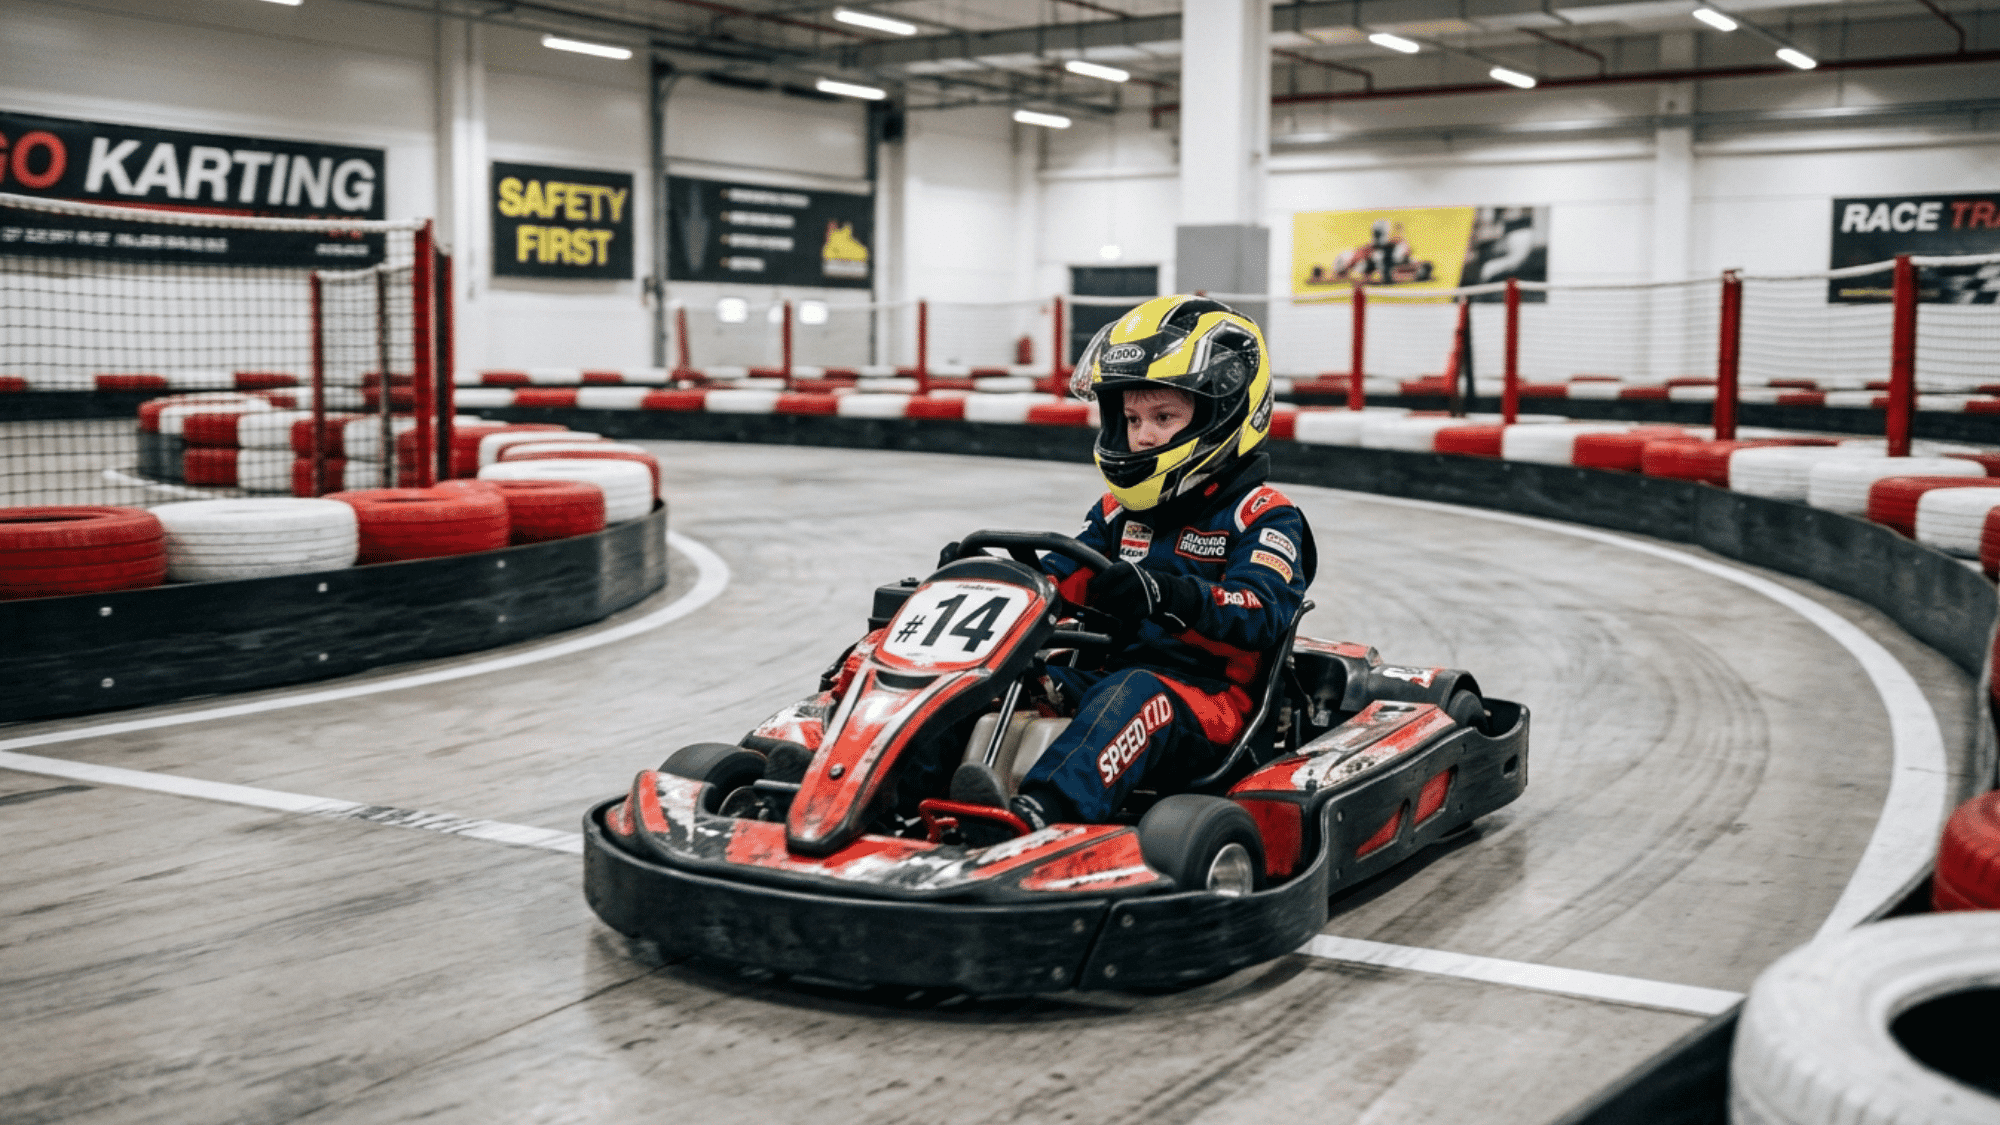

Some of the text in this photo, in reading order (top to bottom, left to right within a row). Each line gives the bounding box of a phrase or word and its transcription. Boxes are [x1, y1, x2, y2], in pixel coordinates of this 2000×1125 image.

[0, 128, 377, 213] O KARTING
[497, 176, 628, 223] SAFETY
[1841, 201, 1944, 233] RACE
[515, 224, 614, 266] FIRST
[894, 593, 1011, 653] #14
[1099, 717, 1147, 784] SPEED
